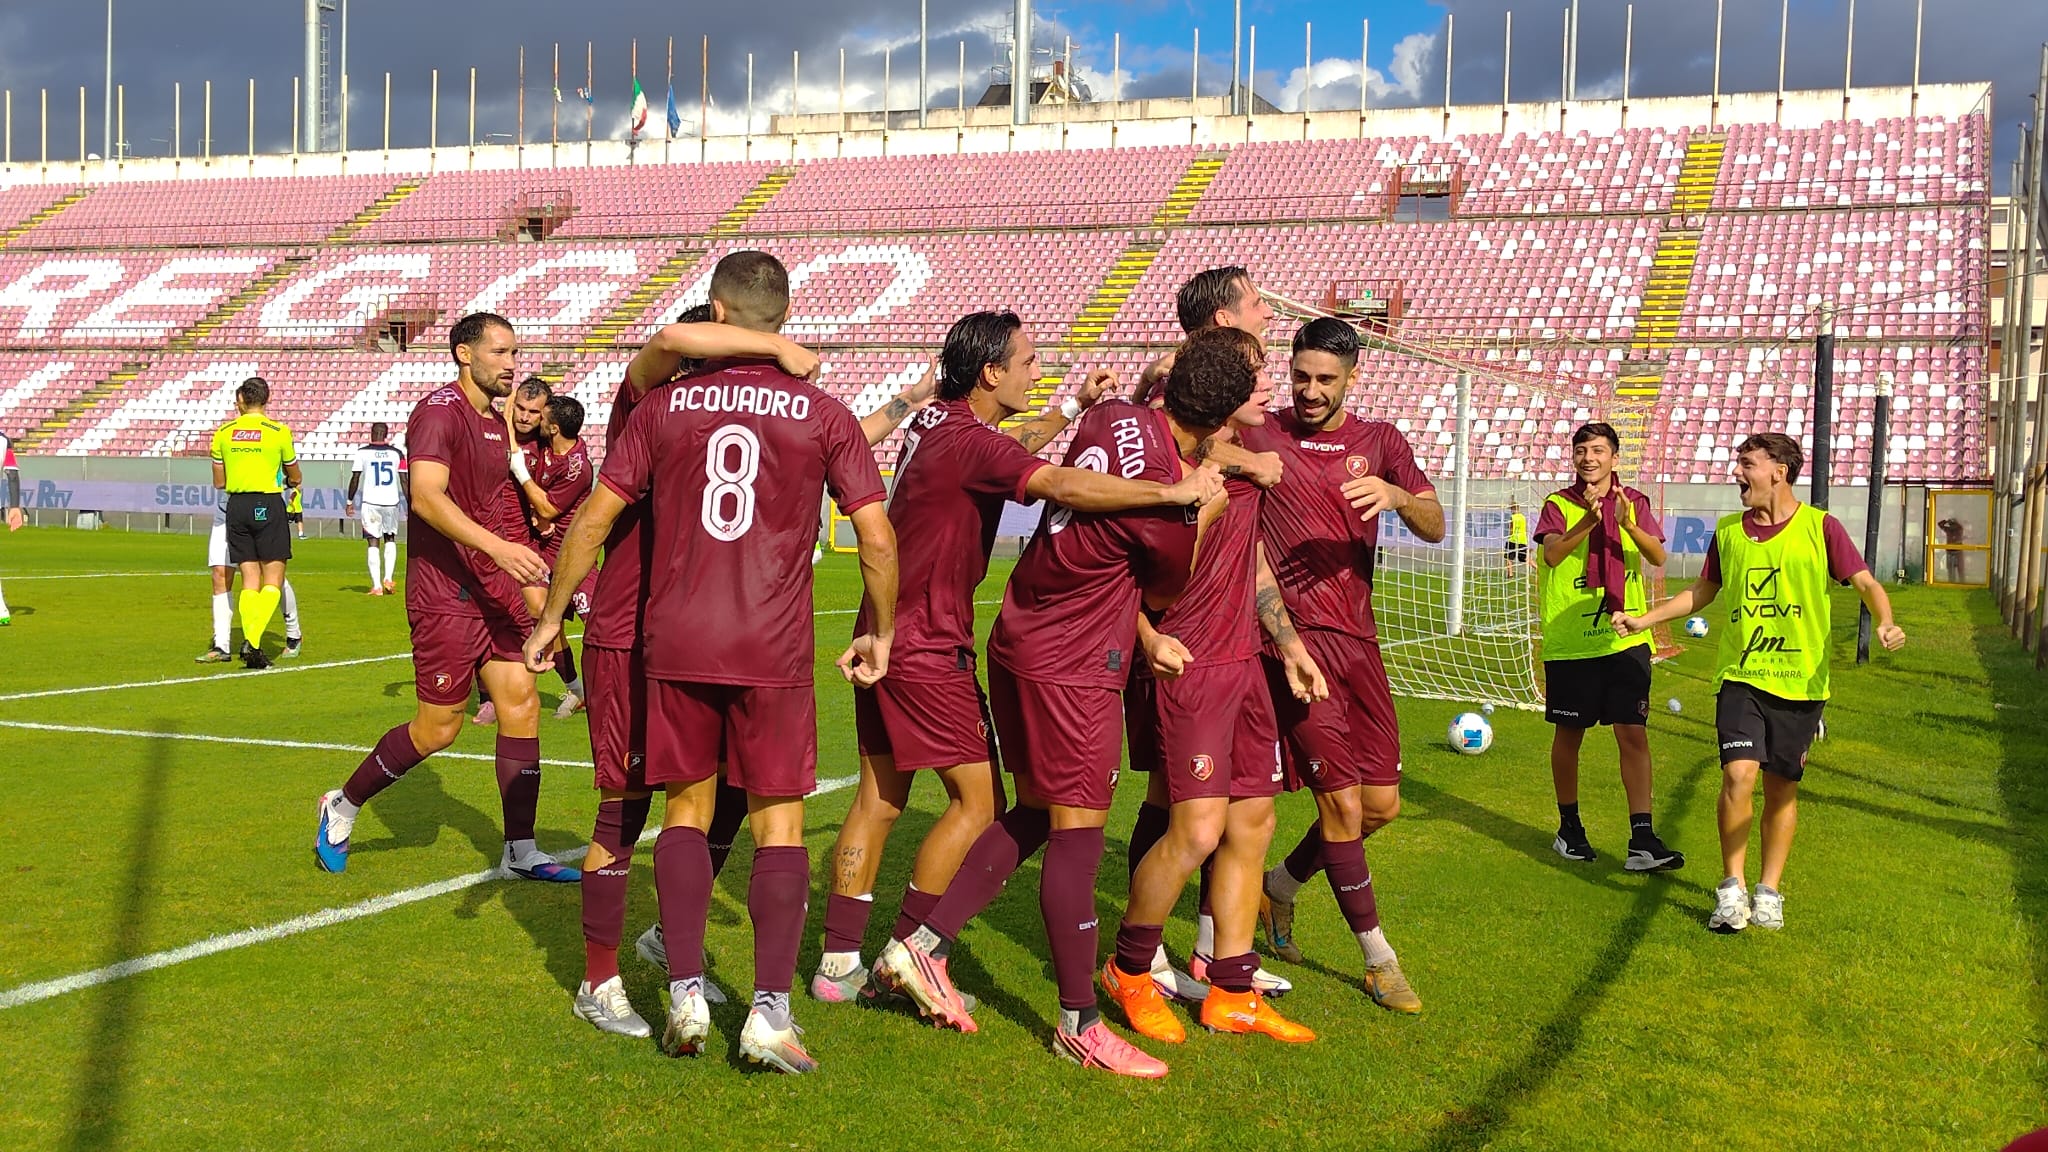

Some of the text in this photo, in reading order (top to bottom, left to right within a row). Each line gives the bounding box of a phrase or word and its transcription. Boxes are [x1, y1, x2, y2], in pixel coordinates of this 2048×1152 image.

[669, 385, 811, 421] ACQUADRO
[1110, 416, 1147, 480] FAZIO
[1300, 440, 1346, 452] GIVOVA
[370, 461, 394, 487] 15
[700, 423, 761, 542] 8
[155, 484, 214, 507] SEGU
[1731, 604, 1802, 623] GIVOVA
[1739, 625, 1802, 669] fm
[1079, 918, 1099, 930] GIV
